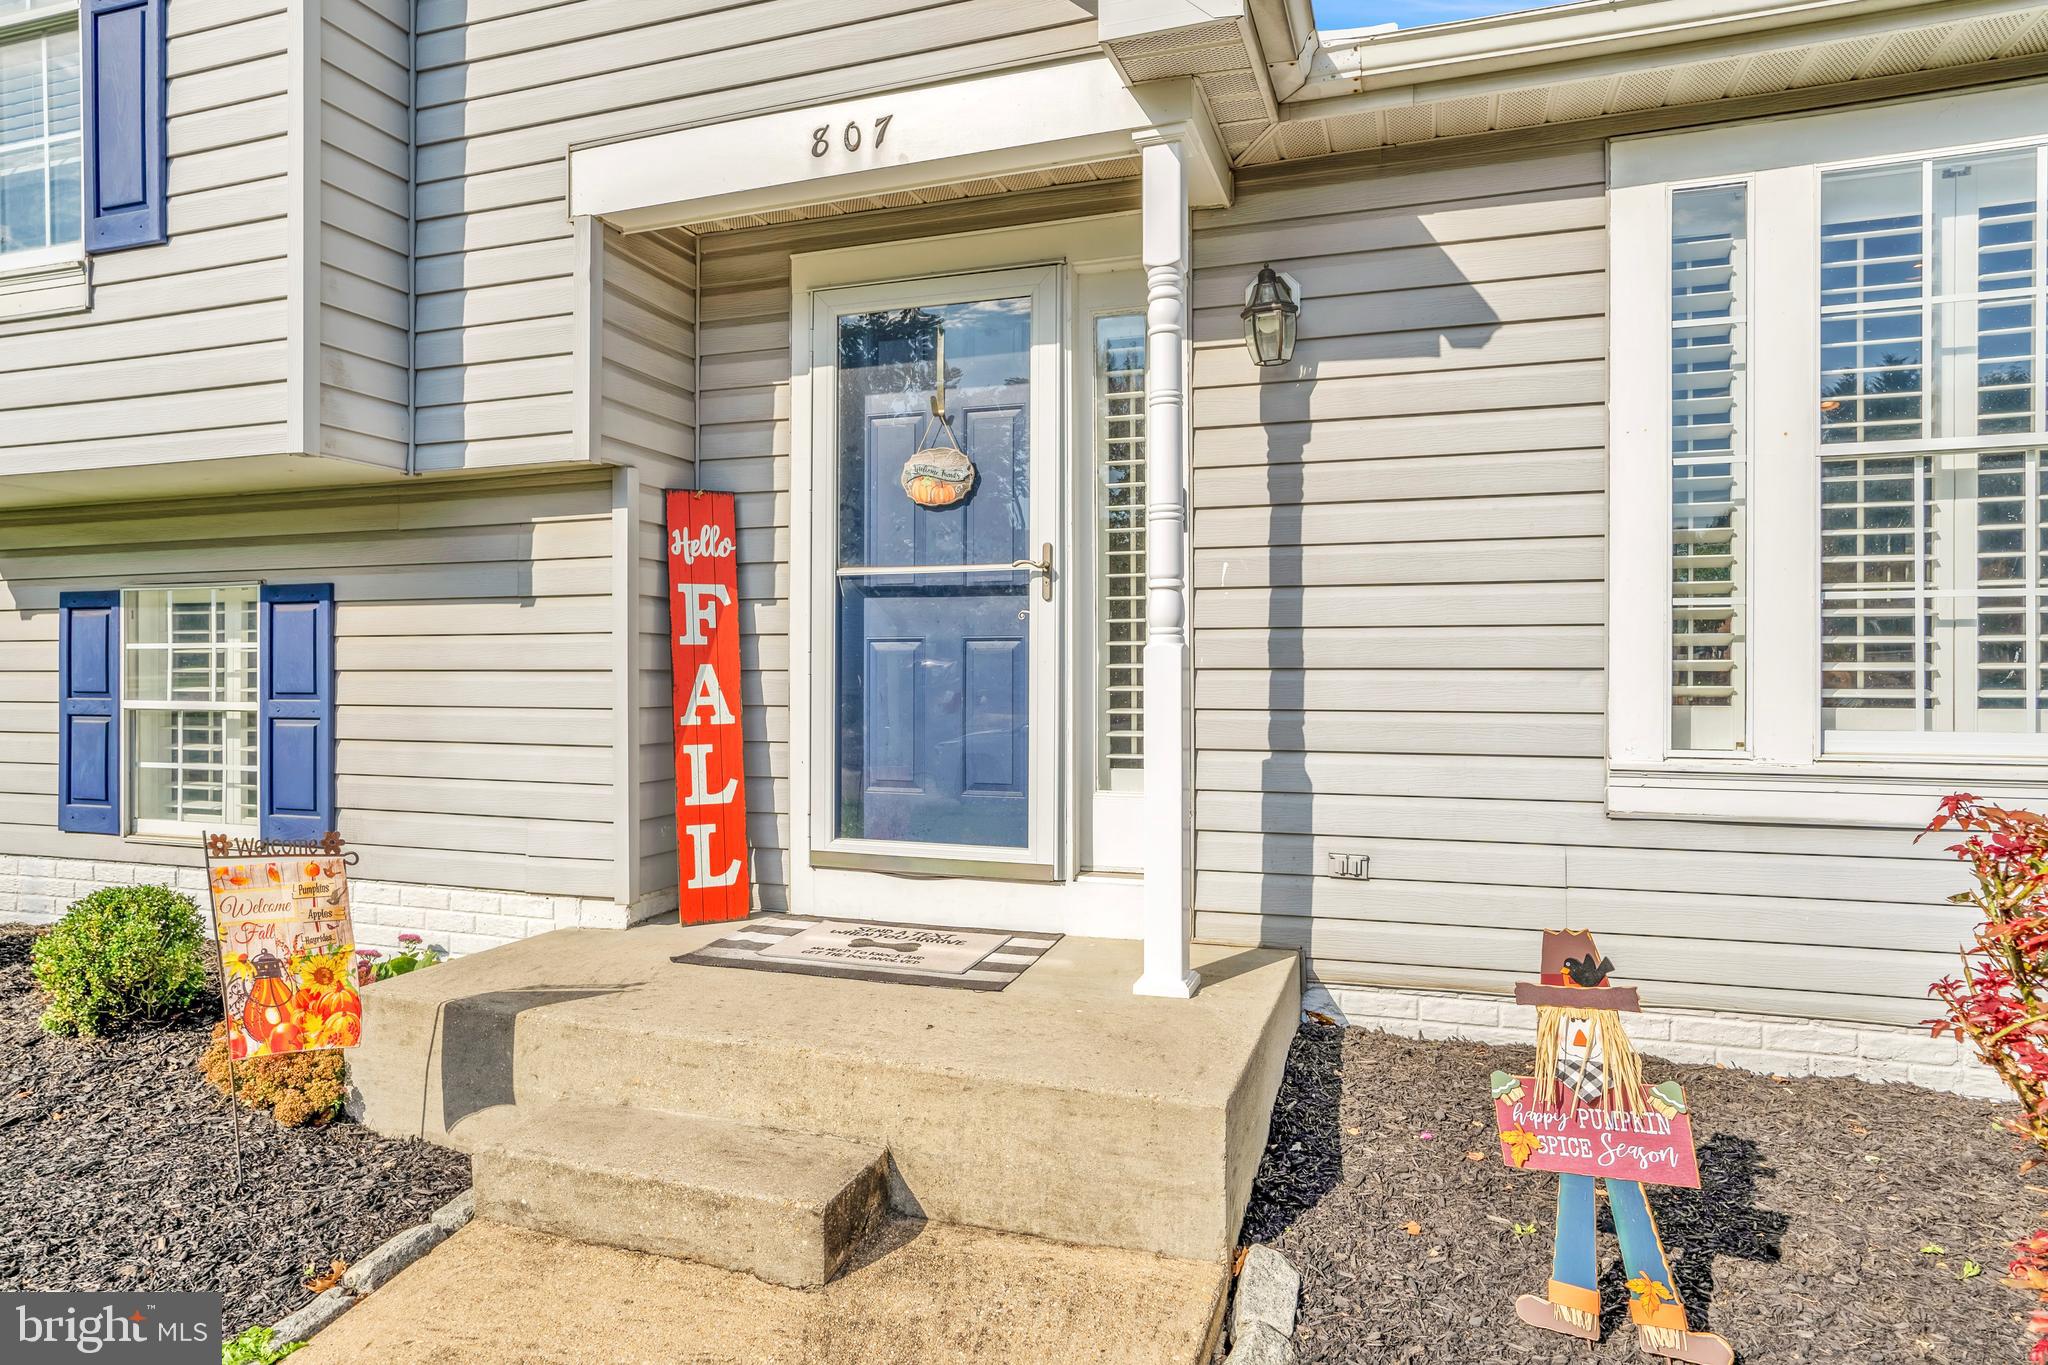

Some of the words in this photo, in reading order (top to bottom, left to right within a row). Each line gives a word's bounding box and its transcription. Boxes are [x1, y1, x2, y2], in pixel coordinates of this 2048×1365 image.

[811, 114, 893, 158] 807
[671, 524, 736, 565] Hello
[677, 582, 743, 889] FALL
[233, 836, 319, 856] Welcome
[299, 882, 330, 896] Pumpkins
[219, 895, 292, 918] Welcome
[308, 908, 333, 920] Apples
[235, 921, 276, 944] Fall
[910, 936, 967, 945] ARRIVE
[912, 931, 957, 939] TEXT
[1512, 1102, 1571, 1132] happy
[1576, 1108, 1672, 1135] PUMPKIN
[1537, 1135, 1593, 1158] SPICE
[1598, 1133, 1679, 1169] Season
